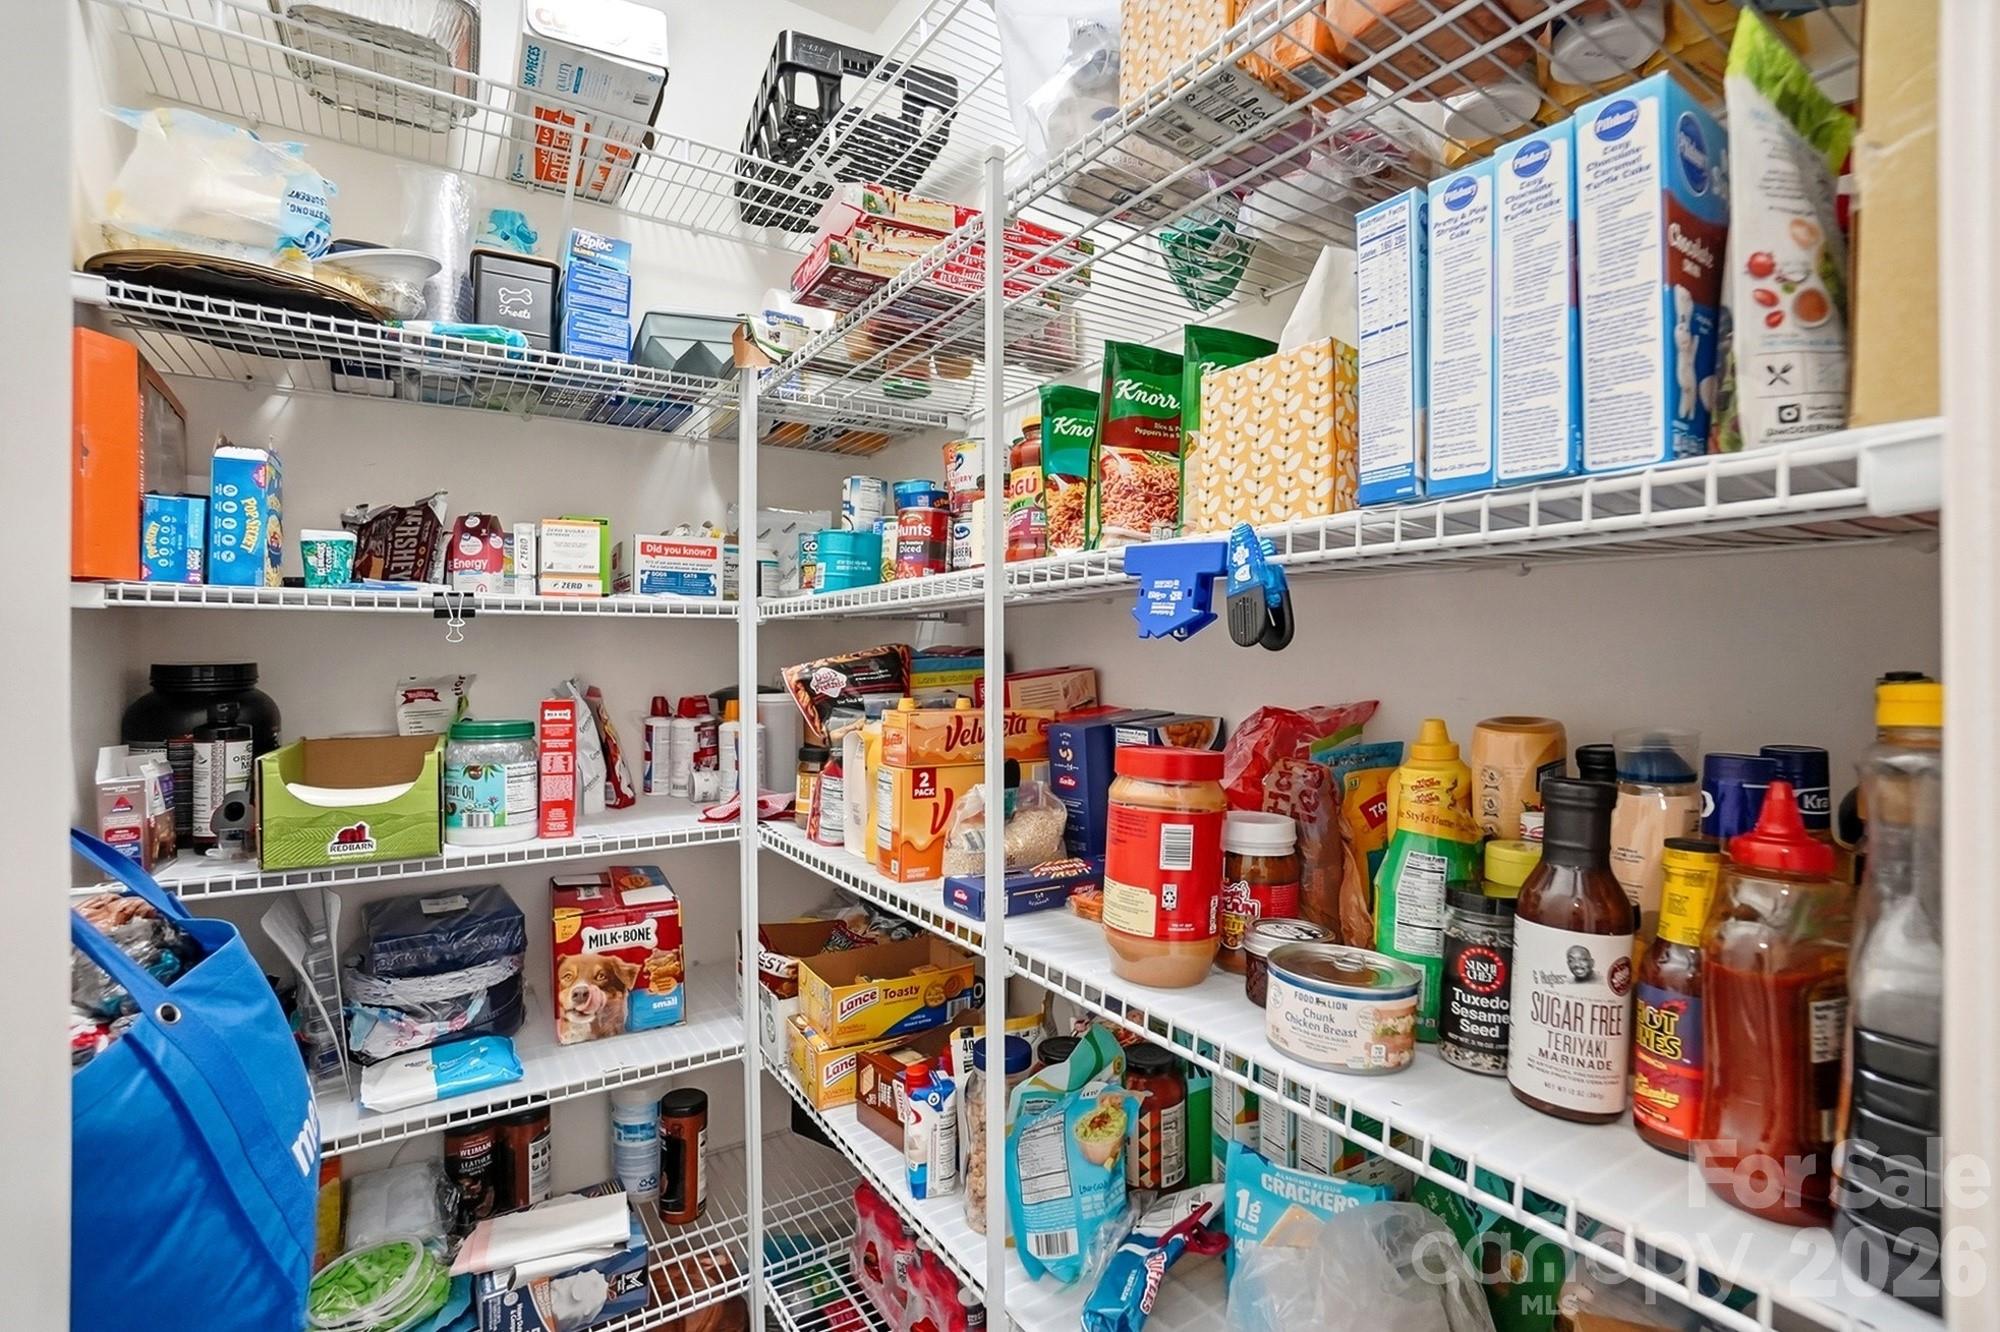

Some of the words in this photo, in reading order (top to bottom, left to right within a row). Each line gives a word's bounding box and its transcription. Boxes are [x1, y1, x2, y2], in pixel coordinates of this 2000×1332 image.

[525, 44, 541, 74] PIECES
[1602, 140, 1632, 155] Easy
[1518, 176, 1545, 191] Easy
[575, 231, 614, 253] Ziploc
[1114, 378, 1182, 411] Knorr
[1052, 415, 1095, 438] Kno
[521, 537, 530, 561] ZERO
[645, 543, 663, 555] Did
[663, 546, 682, 558] you
[682, 546, 713, 558] know?
[452, 556, 490, 573] Energy
[561, 581, 583, 591] ZERO
[945, 711, 1028, 752] Velveta
[919, 771, 930, 787] 2
[461, 785, 475, 801] Oil
[913, 786, 936, 797] PACK
[1802, 793, 1829, 810] Kra
[1406, 809, 1431, 825] Style
[329, 842, 375, 854] REDBARN
[587, 927, 652, 950] MILK-BONE
[757, 952, 787, 973] EST
[652, 995, 678, 1010] small
[838, 989, 878, 1017] Lance
[882, 984, 921, 1000] Toasty
[1293, 990, 1316, 1006] FOOD
[1327, 999, 1349, 1011] LION
[1450, 986, 1511, 1010] Tuxedo
[1284, 1009, 1321, 1033] Chicken
[1322, 1022, 1358, 1039] Breast
[1302, 1006, 1337, 1025] Chunk
[1450, 1001, 1511, 1025] Sesame
[1530, 989, 1585, 1036] SUGAR
[1589, 1003, 1624, 1037] FREE
[1458, 1017, 1501, 1039] Seed
[1547, 1029, 1609, 1059] TERIYAKI
[824, 1055, 857, 1080] Lanc
[1537, 1047, 1614, 1072] MARINADE
[459, 1142, 493, 1158] WEIMAN
[1260, 1173, 1360, 1214] CRACKERS
[1140, 1251, 1170, 1315] RUFFLES
